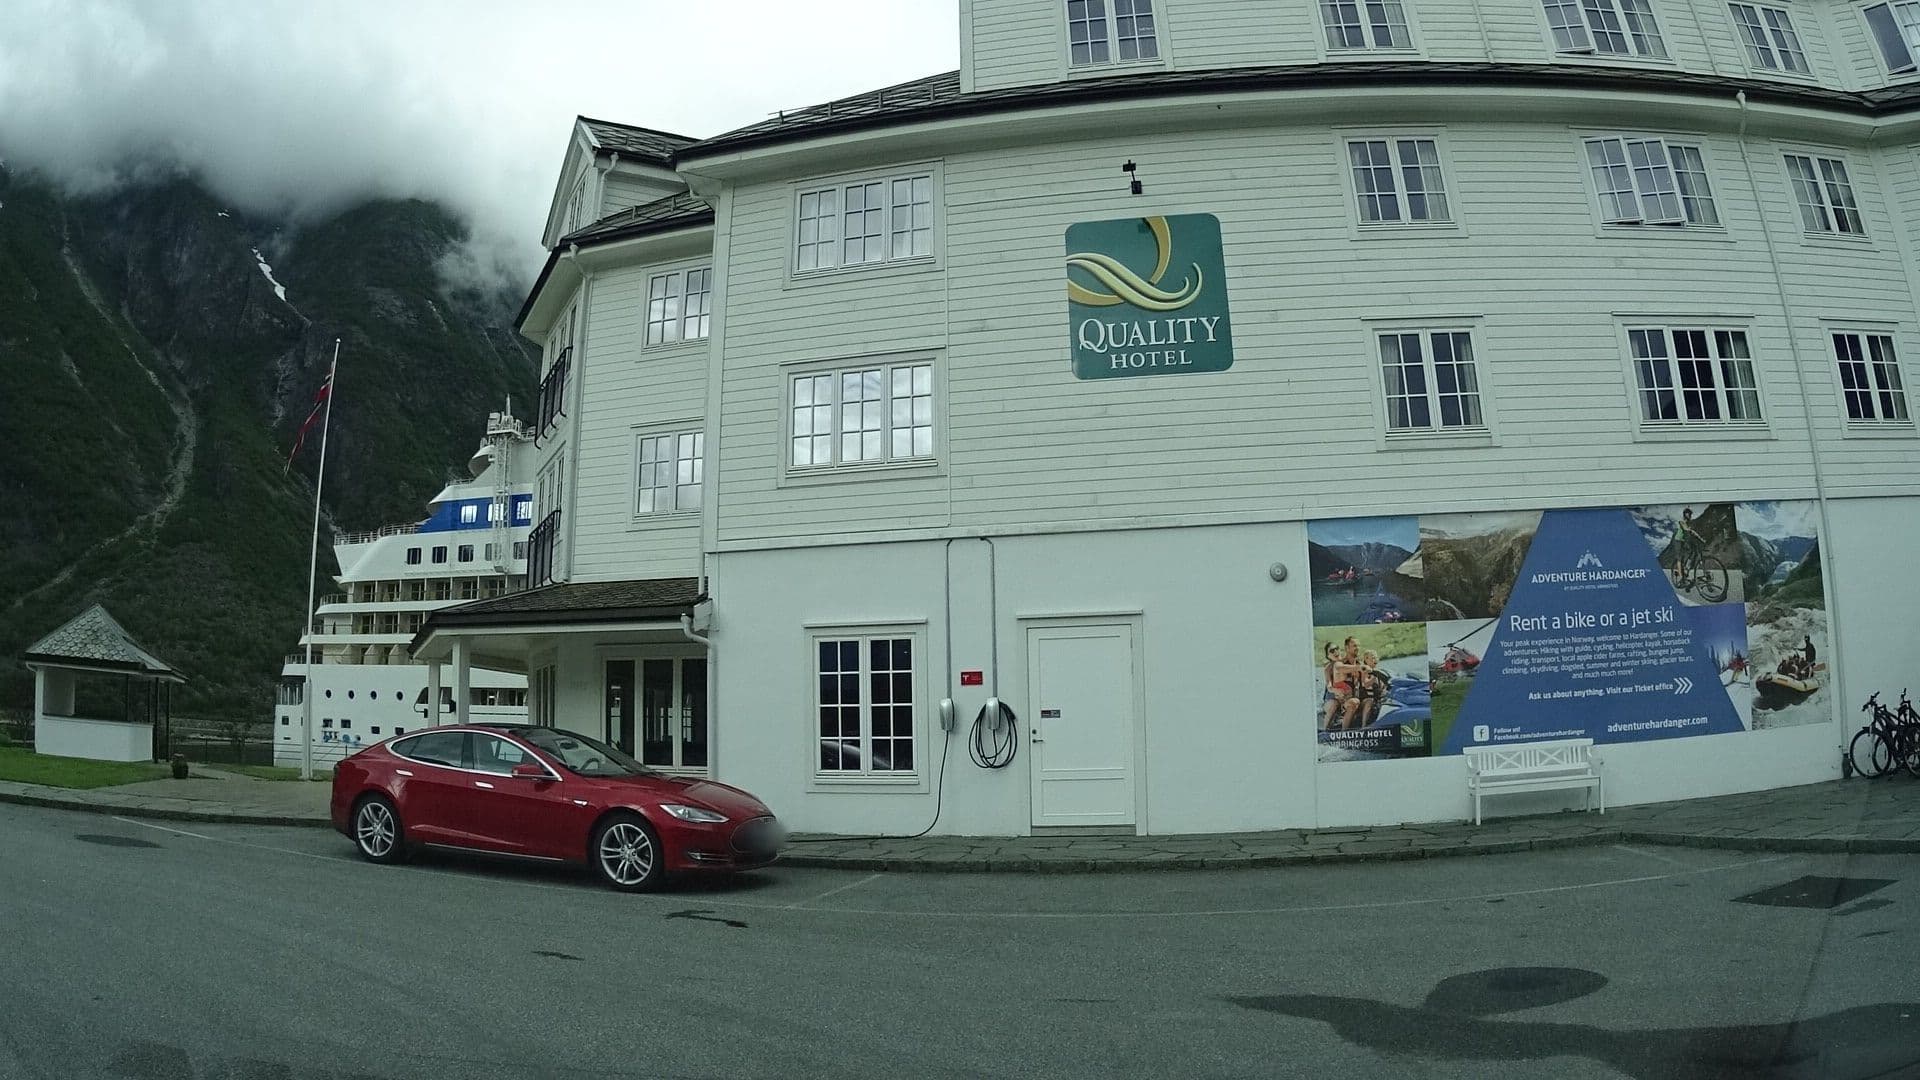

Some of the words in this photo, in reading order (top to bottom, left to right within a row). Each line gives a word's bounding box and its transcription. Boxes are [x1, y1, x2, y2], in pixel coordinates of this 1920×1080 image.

[1079, 316, 1220, 353] QUALITY
[1110, 350, 1192, 369] HOTEL
[1531, 572, 1587, 584] ADVENTURE
[1511, 615, 1547, 632] Rent
[1552, 617, 1561, 629] a
[1565, 611, 1596, 628] bike
[1600, 614, 1615, 626] or
[1619, 613, 1627, 625] a
[1631, 608, 1651, 628] jet
[1654, 606, 1674, 622] ski
[1515, 639, 1530, 647] peak
[1531, 638, 1564, 646] experience
[1540, 646, 1559, 654] Hiking
[1663, 637, 1690, 645] horseback
[1576, 653, 1593, 662] apple
[1660, 657, 1677, 665] glacier
[1600, 669, 1616, 677] much
[1529, 691, 1542, 700] Ask
[1543, 691, 1551, 699] us
[1552, 689, 1572, 698] about
[1573, 687, 1605, 698] anything.
[1606, 685, 1622, 695] Visit
[1623, 685, 1633, 693] our
[1635, 682, 1653, 693] Ticket
[1654, 681, 1674, 691] office
[1607, 716, 1708, 733] adventurehardanger.com
[1330, 731, 1365, 740] QUALITY
[1367, 729, 1393, 738] HOTEL
